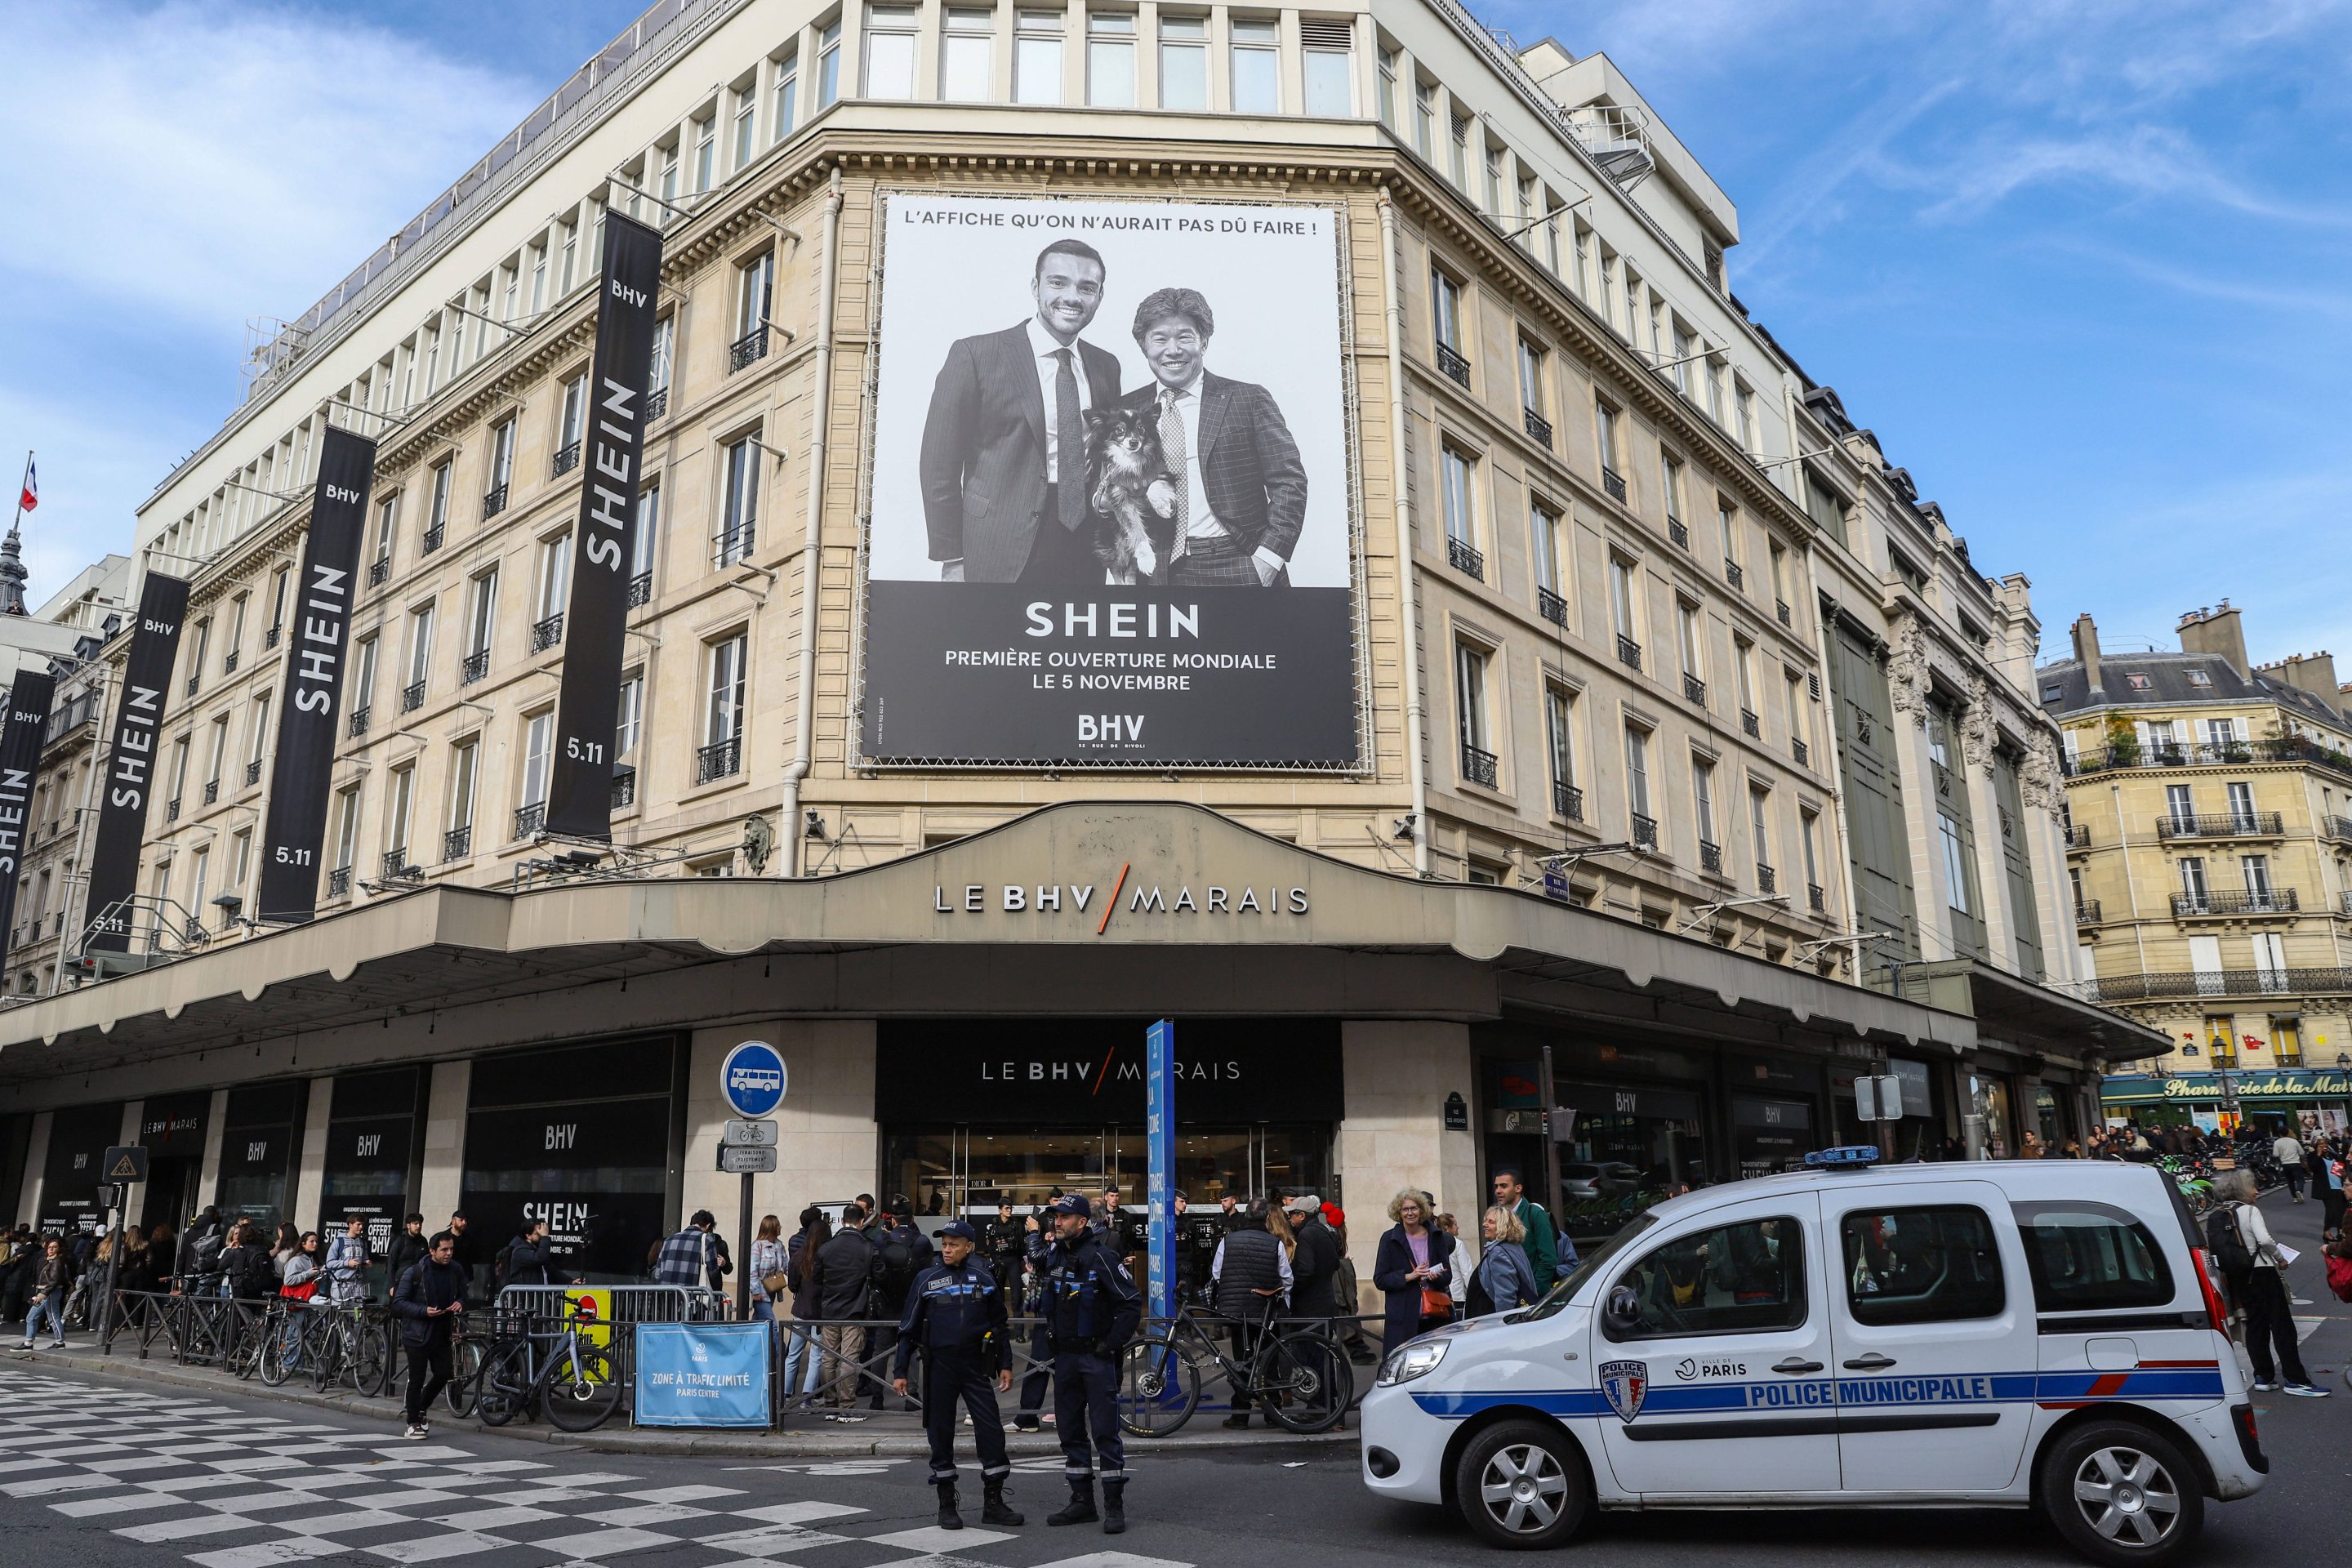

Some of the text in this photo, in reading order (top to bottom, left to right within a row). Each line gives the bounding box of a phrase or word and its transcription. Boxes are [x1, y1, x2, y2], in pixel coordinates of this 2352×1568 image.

[1179, 219, 1214, 231] PAS
[1222, 217, 1246, 233] DÛ
[1254, 221, 1305, 234] FAIRE
[1312, 223, 1316, 234] !
[612, 279, 647, 307] BHV
[587, 376, 637, 572] SHEIN
[327, 484, 359, 504] BHV
[145, 619, 173, 635] BHV
[1026, 602, 1199, 638] SHEIN
[295, 564, 347, 716] SHEIN
[946, 648, 1276, 668] PREMIÈRE OUVERTURE MONDIALE
[1034, 675, 1190, 689] LE 5 NOVEMBRE
[15, 711, 42, 724] BHV
[1078, 715, 1145, 741] BHV
[112, 685, 161, 810] SHEIN
[568, 737, 603, 764] 5.11
[276, 847, 311, 866] 5.11
[933, 885, 983, 911] LE
[1003, 885, 1094, 911] BHV
[1130, 885, 1308, 913] MARAIS
[94, 916, 123, 932] 5.11
[983, 1062, 1014, 1080] LE
[1030, 1062, 1091, 1080] BHV
[1117, 1062, 1240, 1080] MRAIS
[1149, 1087, 1154, 1105] LA
[2165, 1080, 2261, 1096] Pharmcie
[2263, 1078, 2284, 1094] de
[2283, 1077, 2304, 1094] la
[1615, 1092, 1637, 1113] BHV
[1150, 1114, 1159, 1134] ZONE
[1766, 1107, 1780, 1124] BHV
[144, 1117, 197, 1134] LE BHV MARAIS
[357, 1134, 381, 1156] BHV
[546, 1124, 577, 1150] BHV
[74, 1153, 88, 1169] BHV
[247, 1142, 266, 1161] BHV
[971, 1179, 987, 1188] DIOR
[1150, 1173, 1163, 1192] TRAFIC
[368, 1224, 392, 1236] OFFERT
[371, 1236, 390, 1254] BHV
[1151, 1254, 1160, 1272] PARIS
[1151, 1281, 1163, 1300] CENTRE
[1601, 1363, 1645, 1374] POLICE
[1602, 1371, 1645, 1379] MUNICIPALE
[1703, 1364, 1747, 1377] PARIS
[653, 1370, 751, 1387] ZONE À TRAFIC LIMITÉ
[676, 1389, 719, 1398] PARIS CENTRE
[1752, 1378, 1987, 1406] POLICE MUNICIPALE
